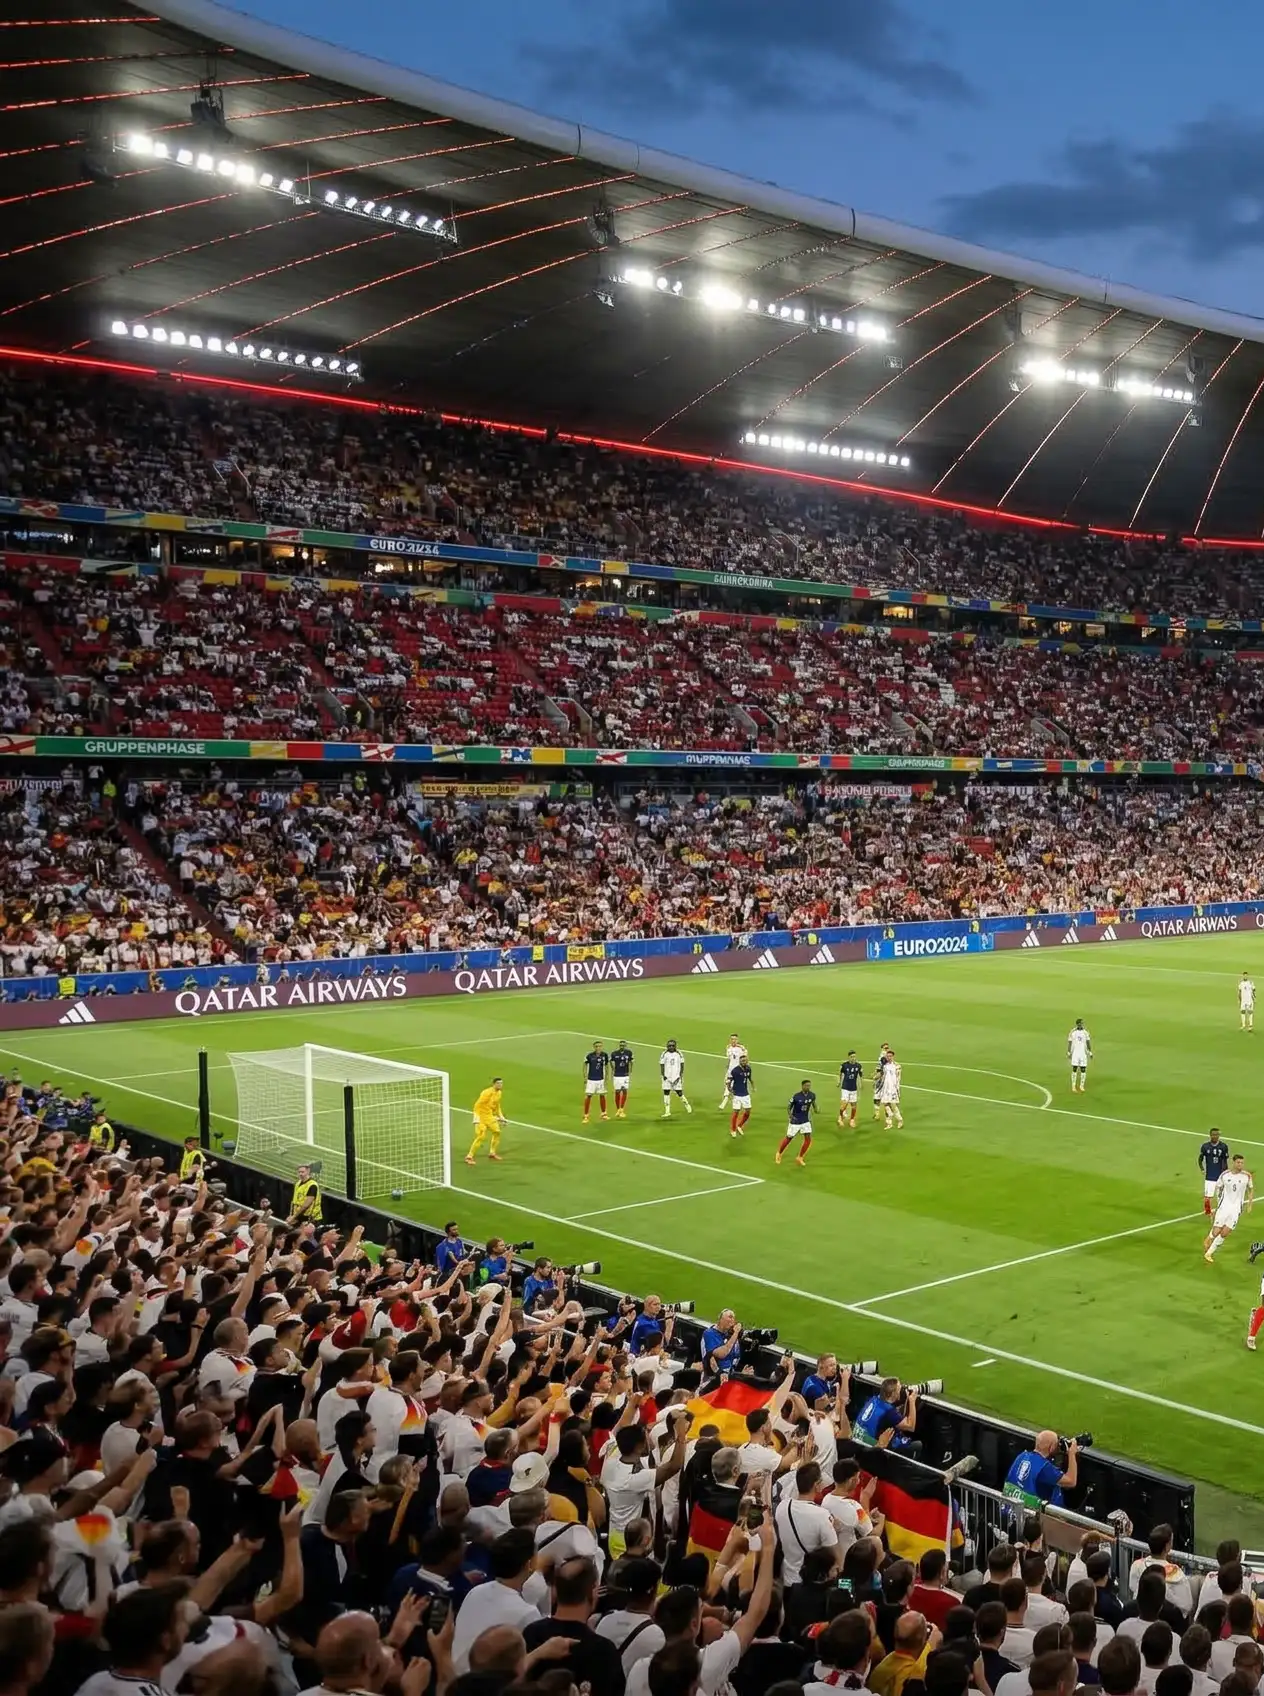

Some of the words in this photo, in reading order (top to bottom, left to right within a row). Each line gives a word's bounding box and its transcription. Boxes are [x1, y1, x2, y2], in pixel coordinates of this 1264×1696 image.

[85, 741, 206, 754] GRUPPENPHASE
[1141, 921, 1184, 938] QATAR
[1187, 914, 1237, 934] AIRWAYS
[894, 936, 969, 956] EURO2024
[455, 969, 538, 993] QATAR
[546, 957, 645, 984] AIRWAYS
[175, 987, 278, 1016] QATAR
[286, 976, 407, 1004] AIRWAYS
